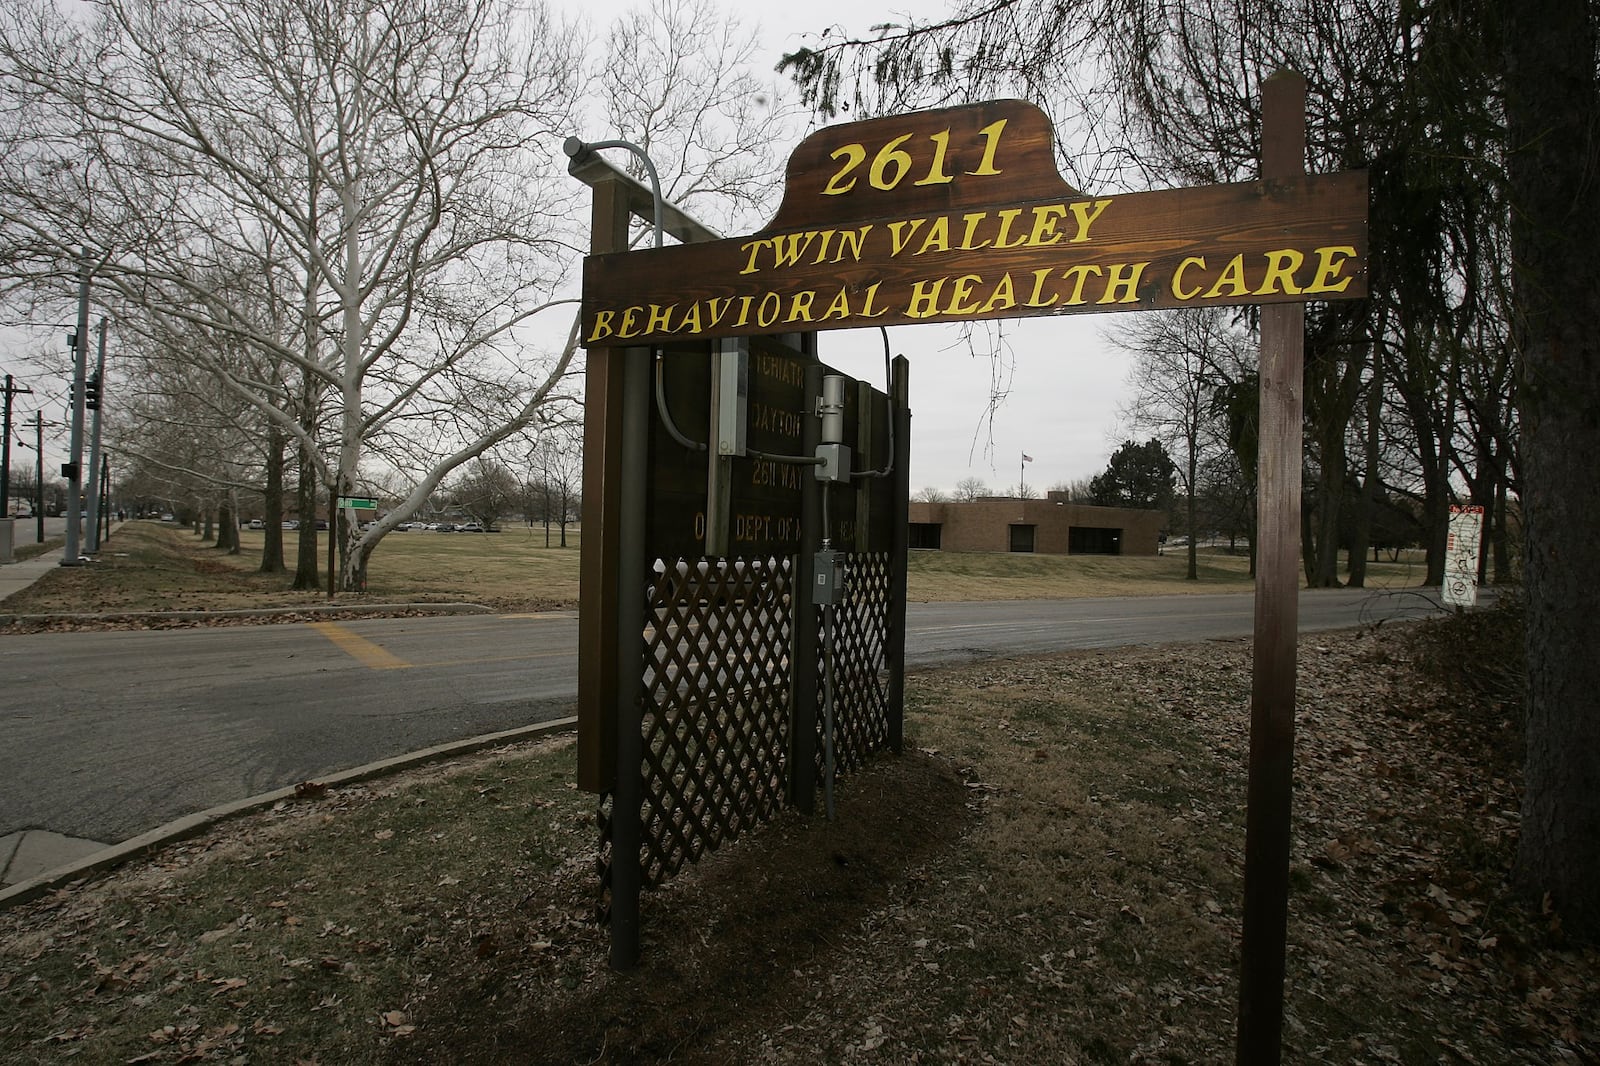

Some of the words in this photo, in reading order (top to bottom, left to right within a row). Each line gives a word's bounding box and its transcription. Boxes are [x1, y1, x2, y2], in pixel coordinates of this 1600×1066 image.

[820, 118, 1008, 196] 2611
[739, 224, 873, 275] TWIN
[887, 199, 1113, 258] VALLEY
[587, 280, 890, 342] BEHAVIORAL
[903, 261, 1151, 319] HEALTH
[1170, 246, 1357, 301] CARE
